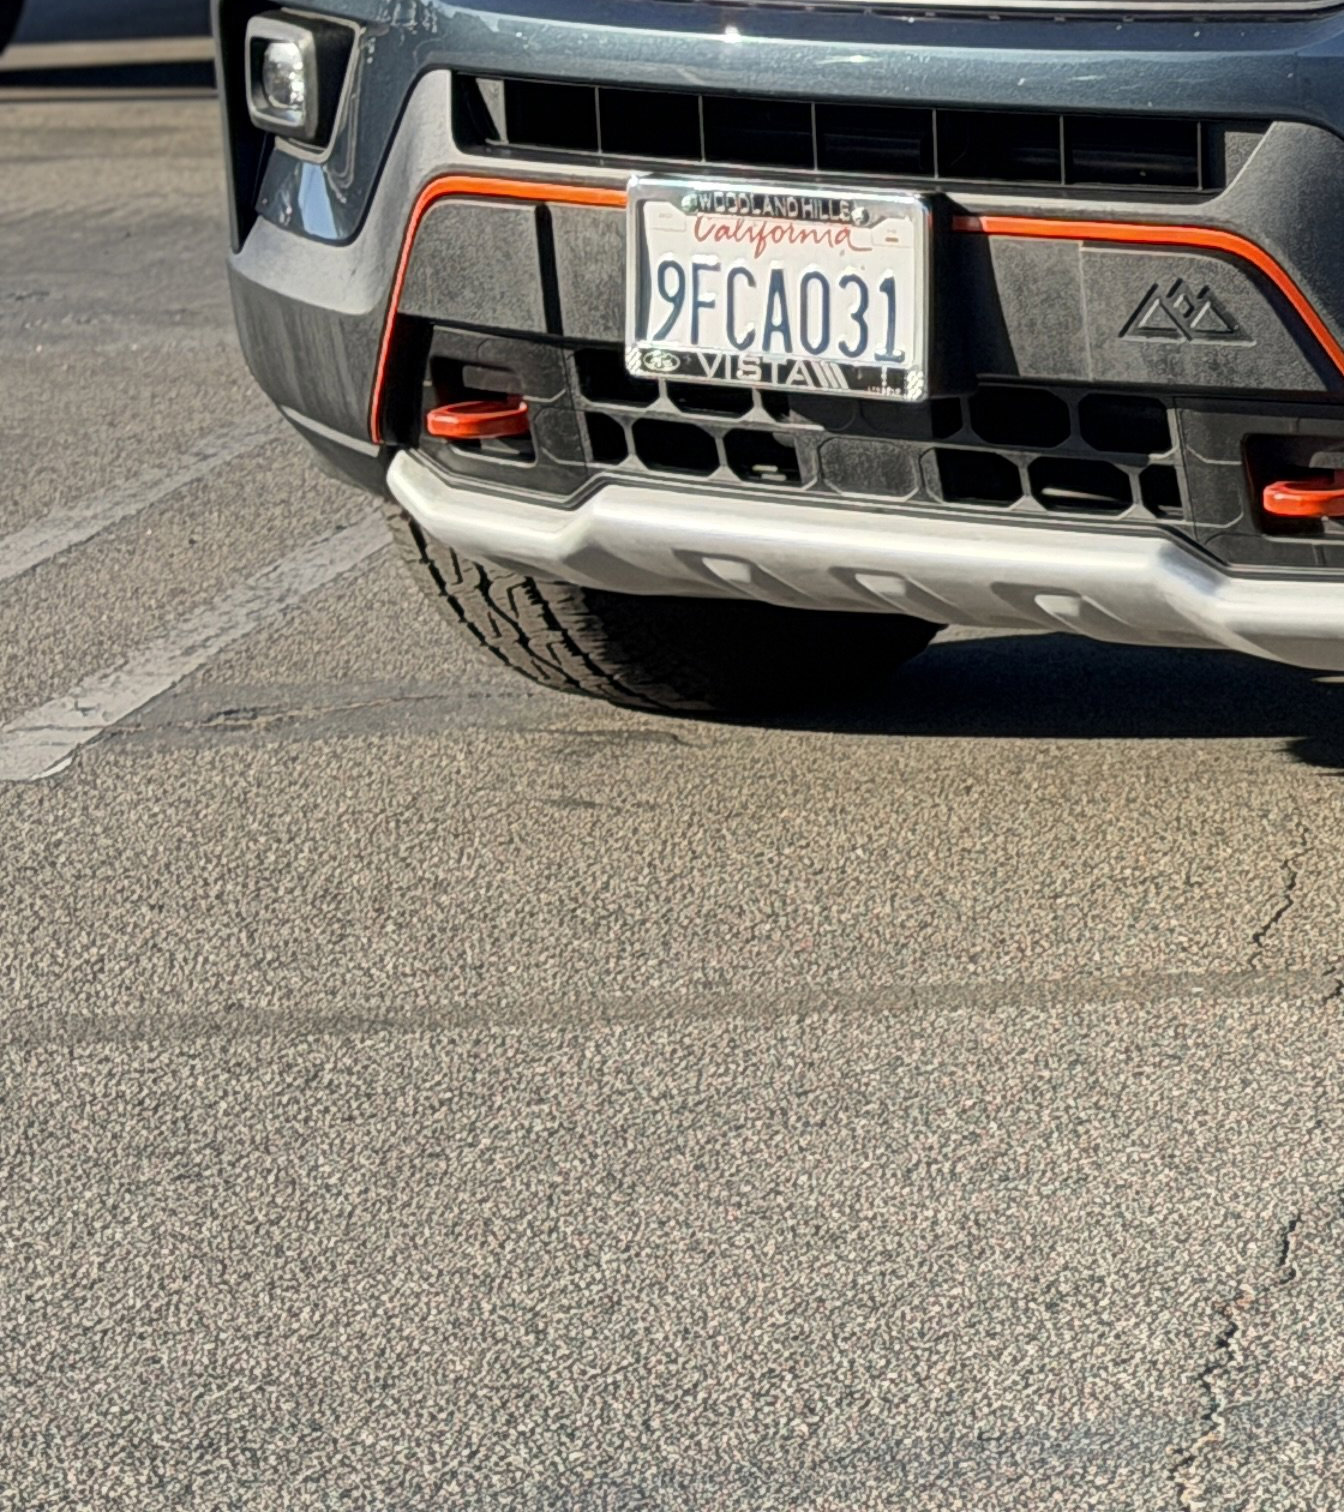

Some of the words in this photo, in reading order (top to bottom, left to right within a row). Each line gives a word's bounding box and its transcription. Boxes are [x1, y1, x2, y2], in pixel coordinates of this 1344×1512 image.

[699, 192, 799, 218] WOODLAND
[802, 198, 850, 223] HILLS
[693, 213, 873, 259] California
[652, 256, 907, 362] 9FCA031
[697, 351, 818, 386] VISTA
